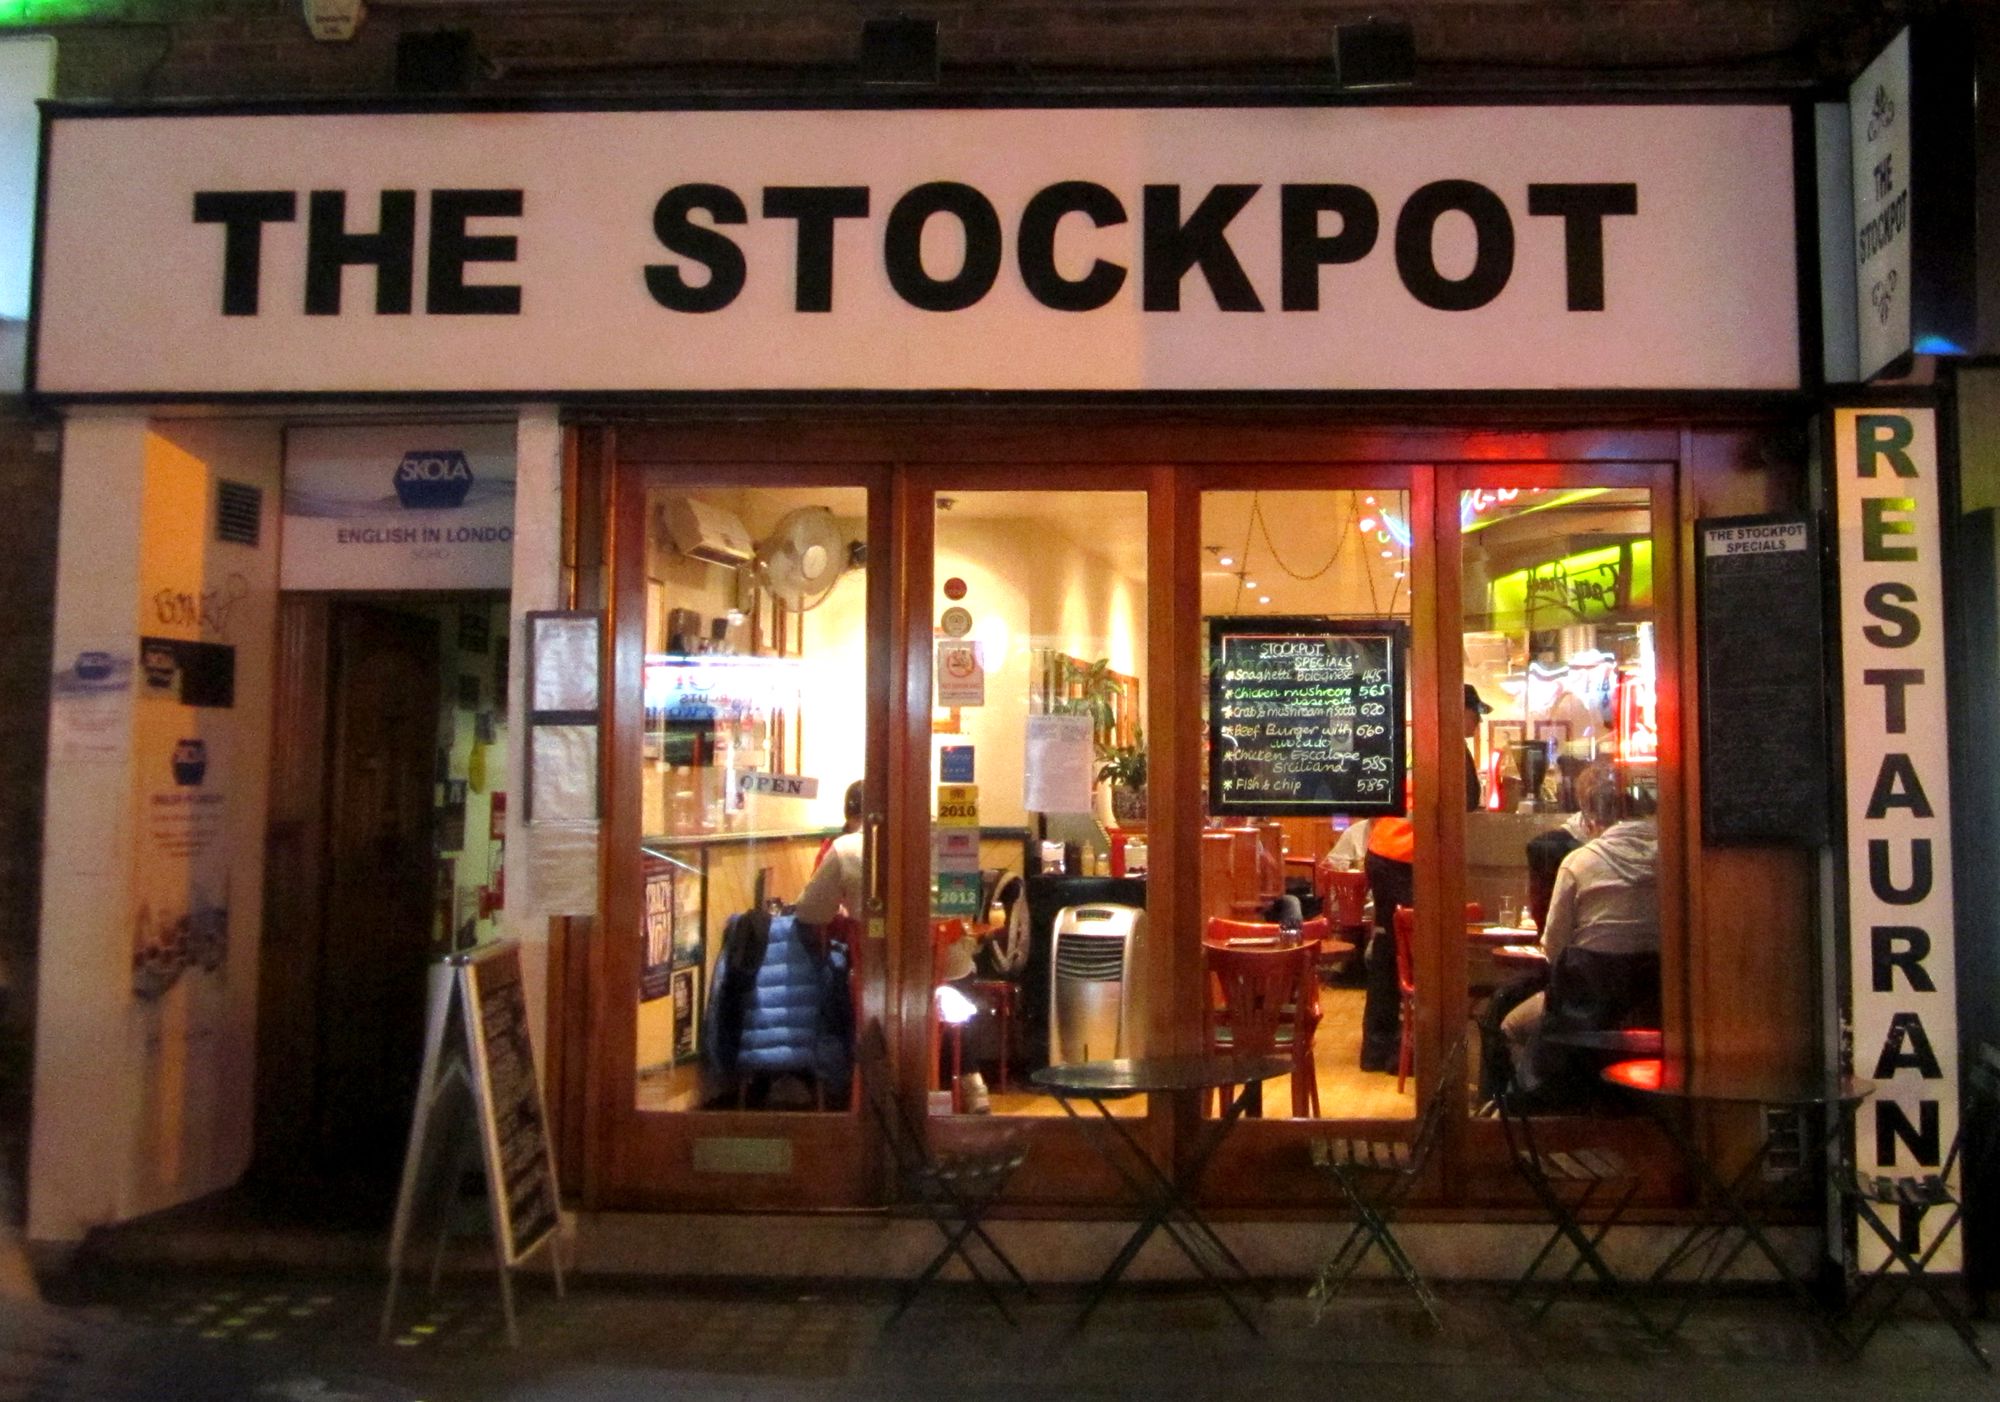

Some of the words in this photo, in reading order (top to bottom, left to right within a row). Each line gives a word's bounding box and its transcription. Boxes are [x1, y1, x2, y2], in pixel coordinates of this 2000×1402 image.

[1873, 153, 1892, 202] THE
[1860, 189, 1907, 264] STOCKPOT
[193, 189, 523, 316] THE
[643, 180, 1639, 315] STOCKPOT
[401, 459, 469, 481] SKOLA
[337, 528, 416, 544] ENGLISH
[422, 527, 440, 543] IN
[1709, 530, 1734, 541] THE
[1737, 525, 1804, 540] STOCKPOT
[1726, 540, 1786, 553] SPECIALS
[1260, 642, 1325, 655] STOCKPOT
[1235, 668, 1290, 683] Spaghetti
[1297, 669, 1354, 682] Bolognese
[1235, 687, 1280, 699] Chicken
[1284, 684, 1351, 697] mushroom
[1267, 705, 1324, 718] mushroom
[1234, 724, 1260, 740] Beef
[1265, 723, 1319, 740] Burger
[1322, 724, 1352, 736] with
[1234, 749, 1287, 761] Chicken
[1291, 749, 1360, 765] Escalope
[740, 775, 804, 795] OPEN
[1274, 780, 1302, 795] chip
[940, 805, 976, 817] 2010
[1855, 414, 1942, 1256] RESTAURANT
[940, 892, 976, 904] 2012
